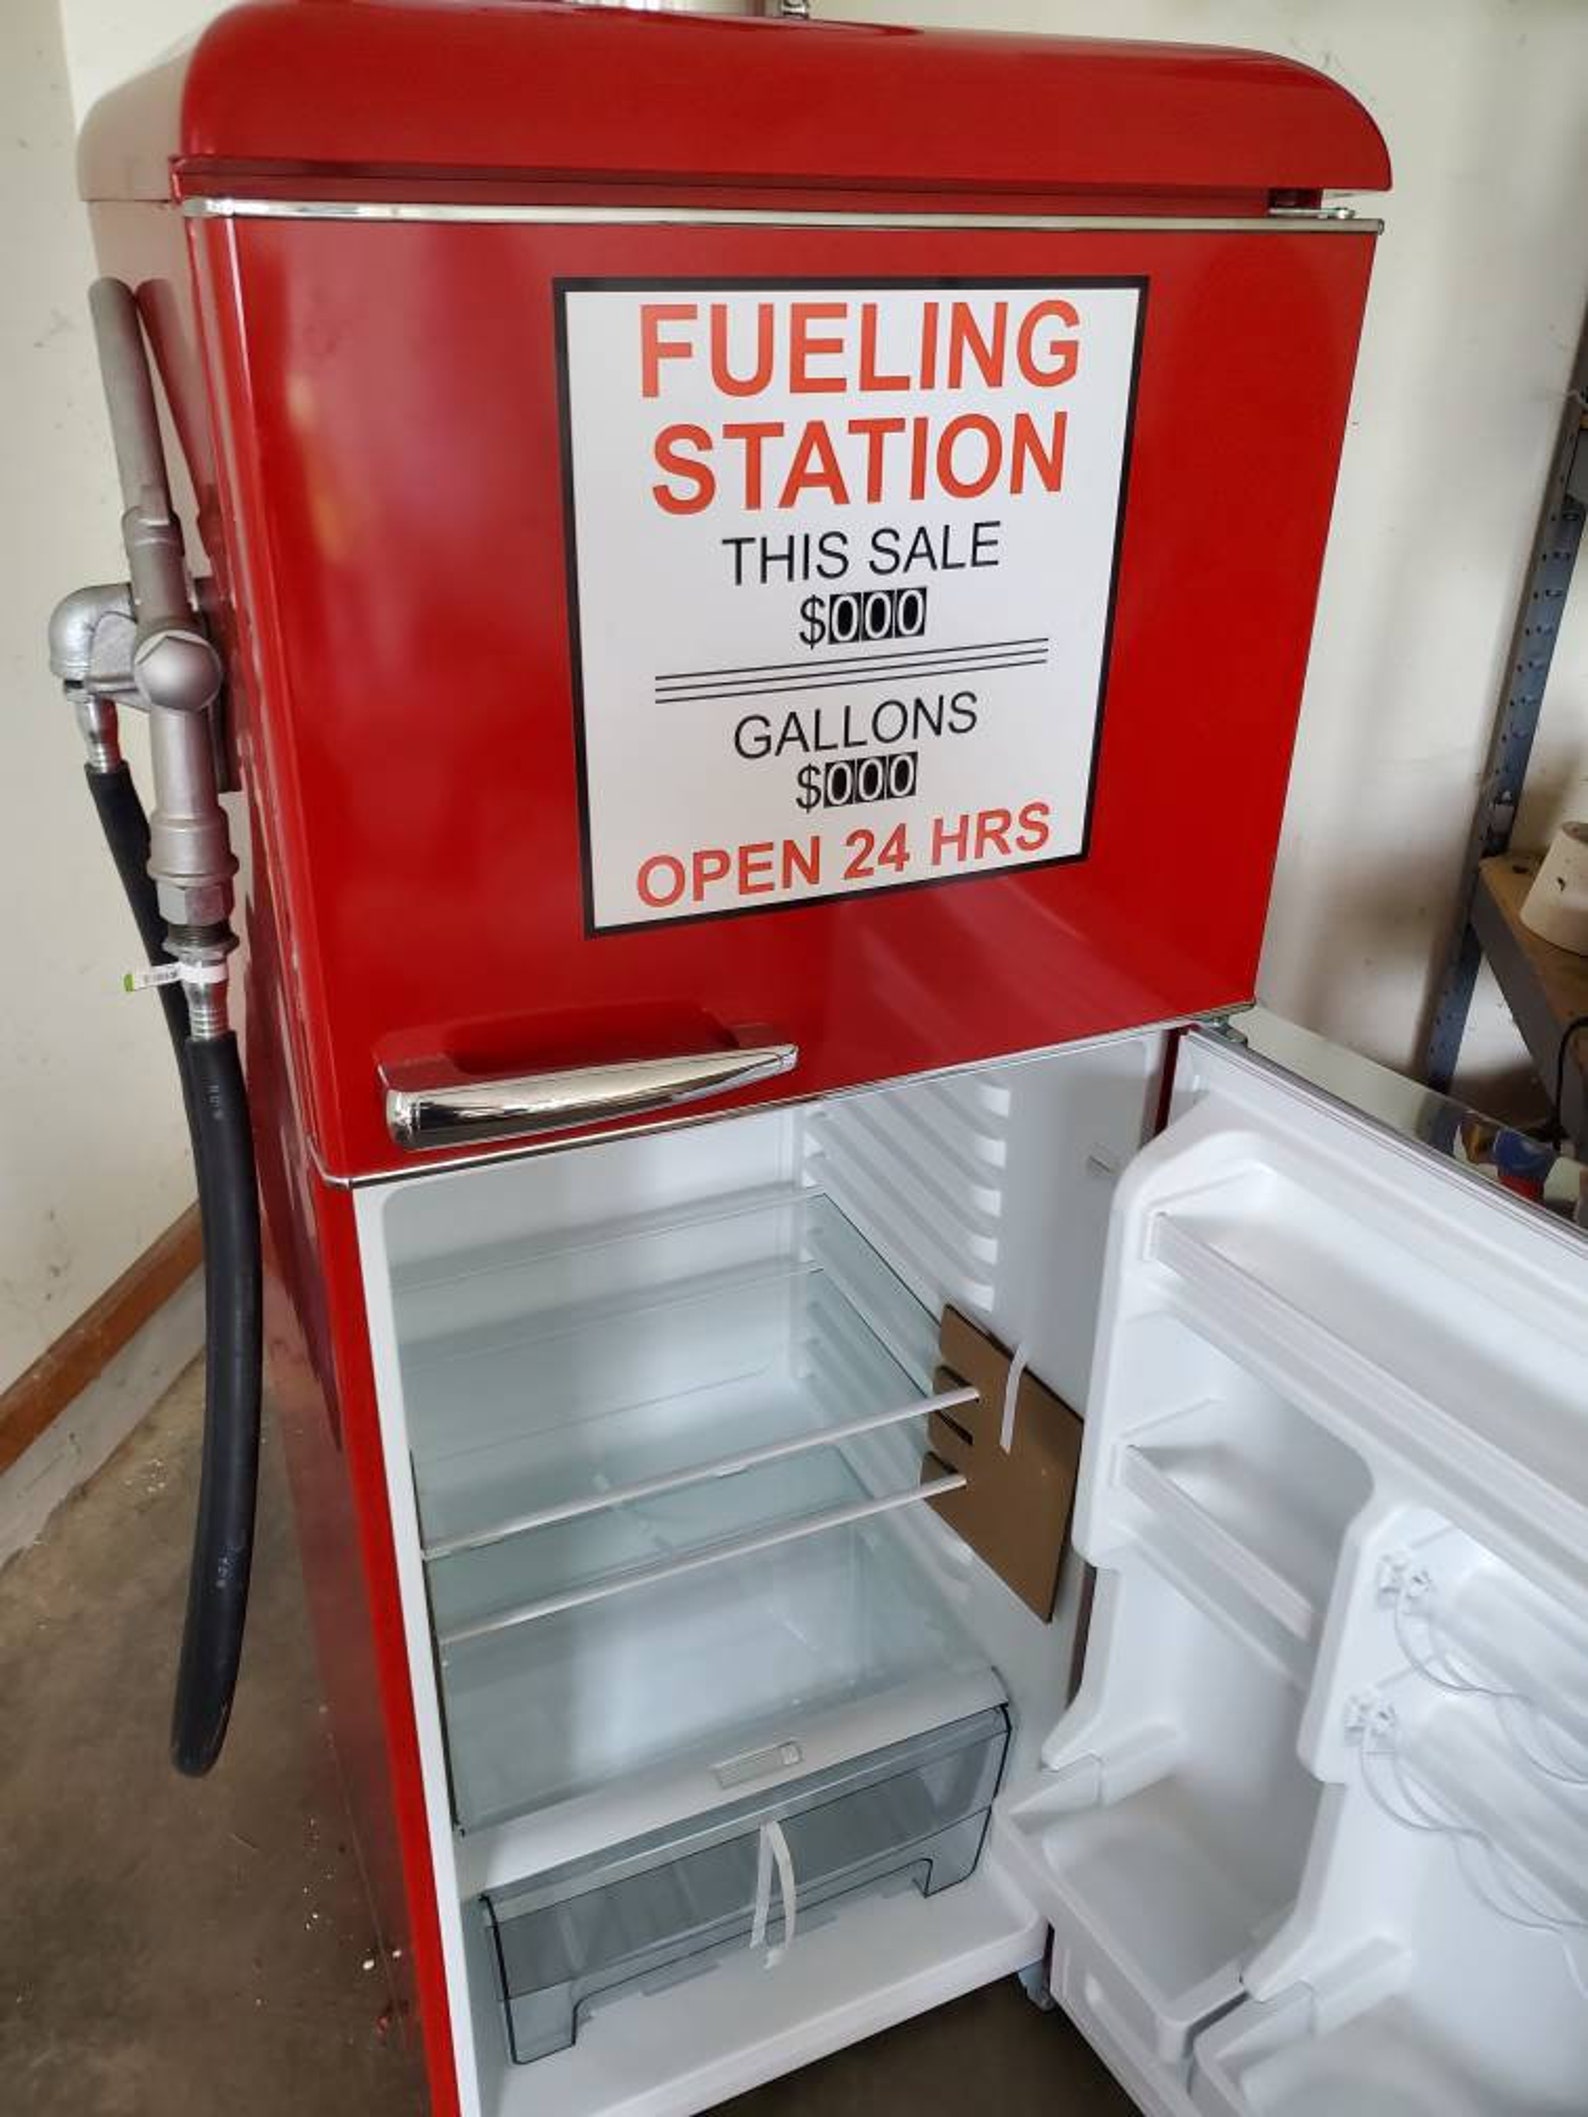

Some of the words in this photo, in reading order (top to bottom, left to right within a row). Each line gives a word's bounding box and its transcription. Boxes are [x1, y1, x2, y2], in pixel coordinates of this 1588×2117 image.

[640, 299, 1080, 398] FUELING
[652, 411, 1068, 515] STATION
[721, 530, 850, 586] THIS
[868, 520, 1001, 577] SALE
[799, 586, 928, 649] $000
[733, 691, 979, 759] GALLONS
[795, 751, 919, 813] $000
[636, 836, 820, 908] OPEN
[843, 824, 910, 881] 24
[932, 801, 1052, 867] HRS
